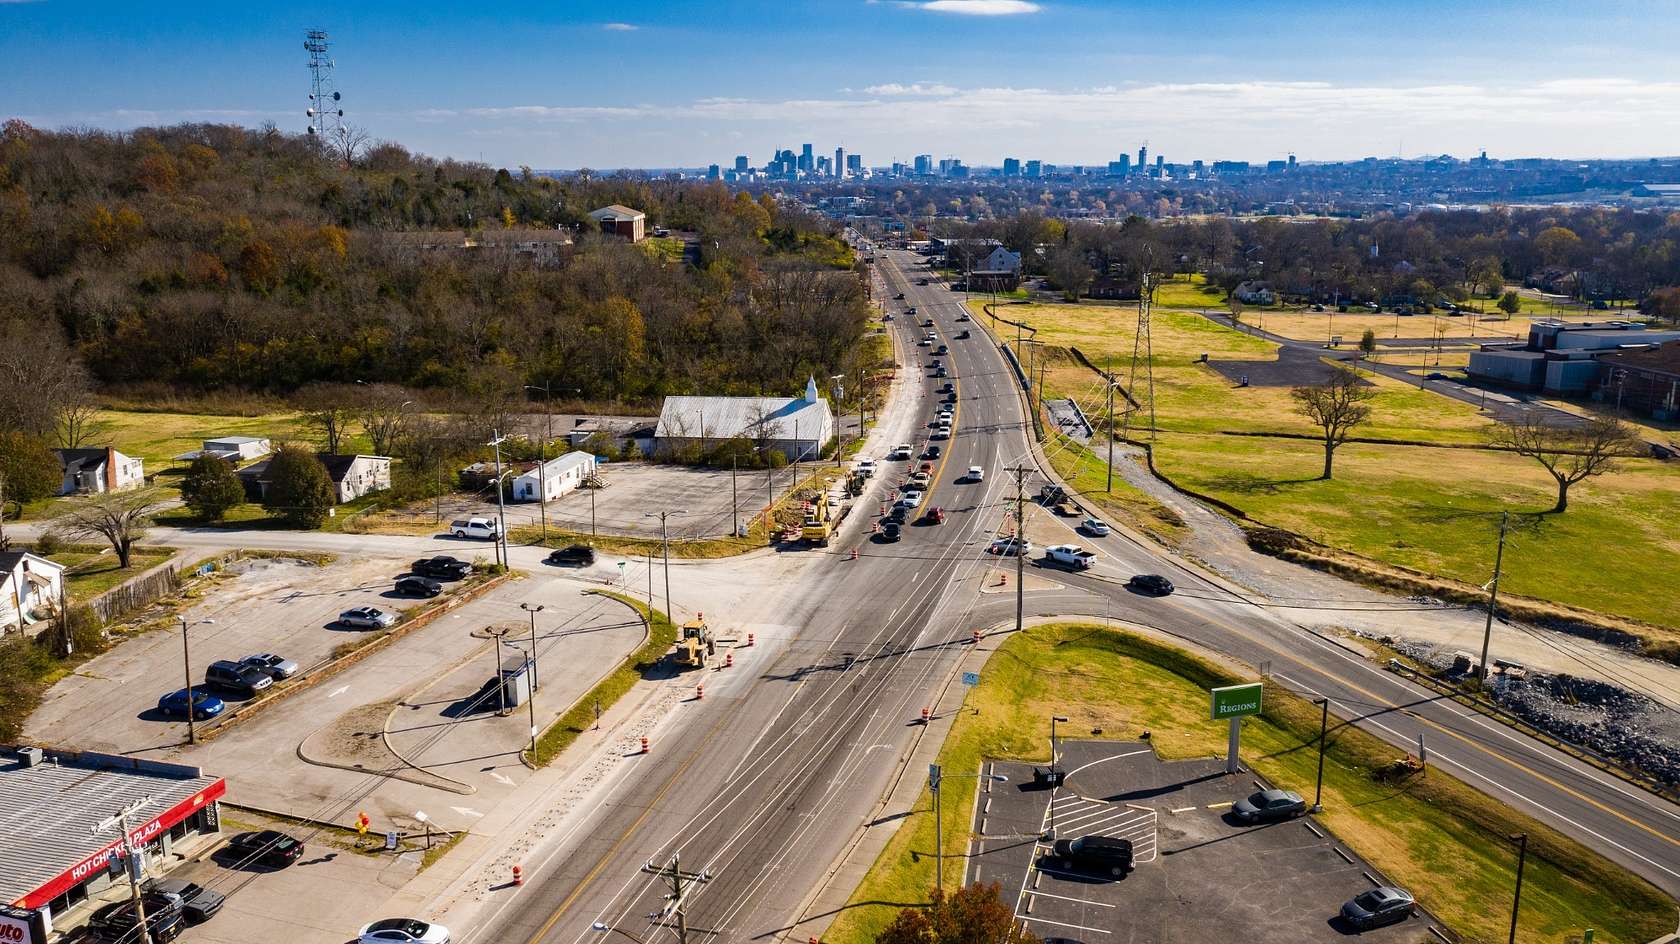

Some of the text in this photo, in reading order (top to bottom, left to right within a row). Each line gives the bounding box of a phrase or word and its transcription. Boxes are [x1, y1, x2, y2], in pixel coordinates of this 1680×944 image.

[1220, 702, 1256, 713] REGIONS
[72, 860, 93, 880] HOT
[133, 819, 162, 844] PLAZA
[0, 924, 24, 942] uto
